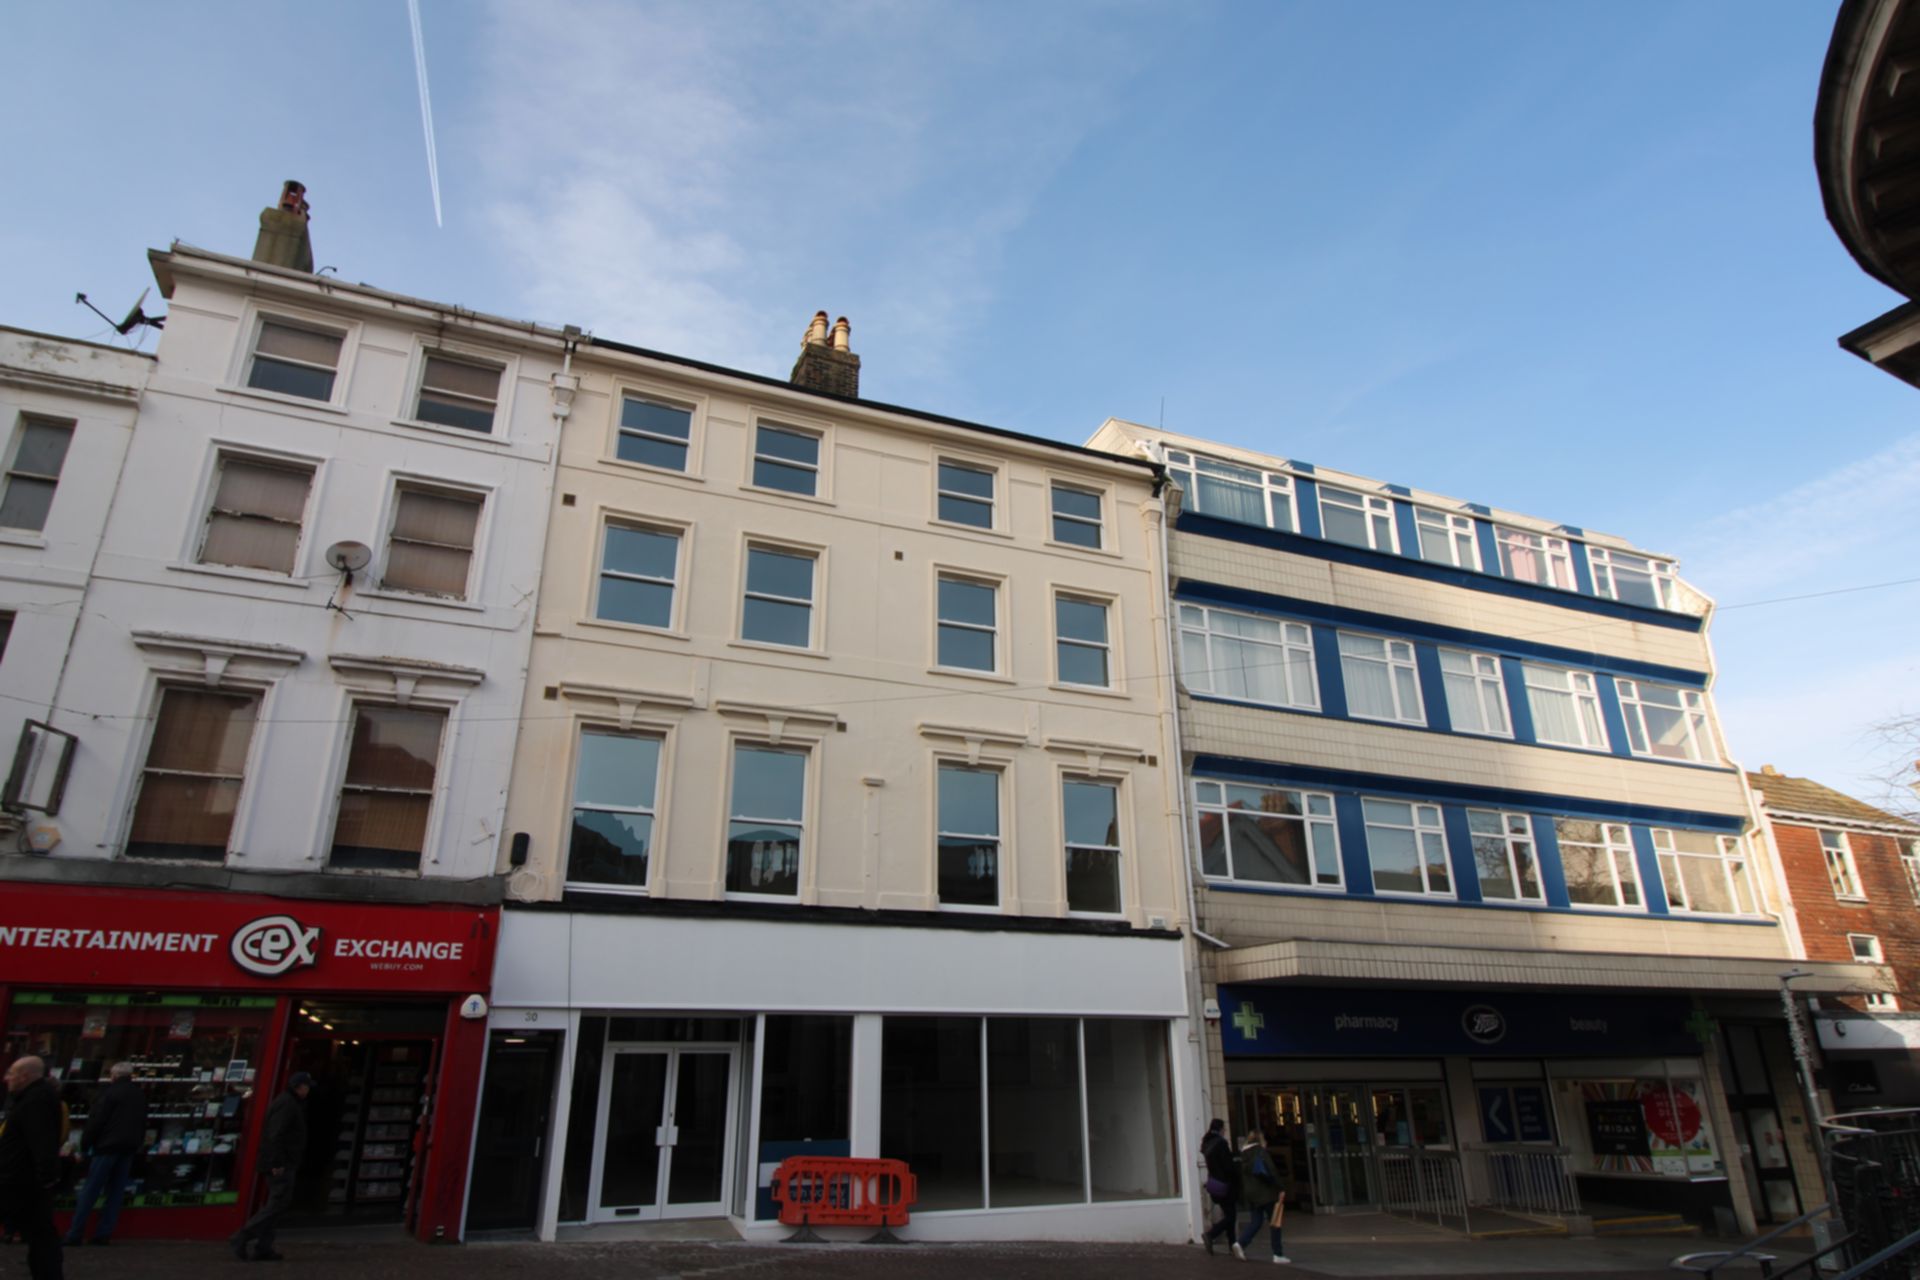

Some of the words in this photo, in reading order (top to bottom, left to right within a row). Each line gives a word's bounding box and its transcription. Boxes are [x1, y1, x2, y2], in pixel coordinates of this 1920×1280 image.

[333, 938, 463, 960] EXCHANGE
[369, 962, 424, 971] WEBUY.COM
[524, 1011, 538, 1022] 30
[1334, 1013, 1399, 1032] pharmacy
[1569, 1016, 1608, 1035] beauty
[1597, 1124, 1637, 1134] FRIDAY
